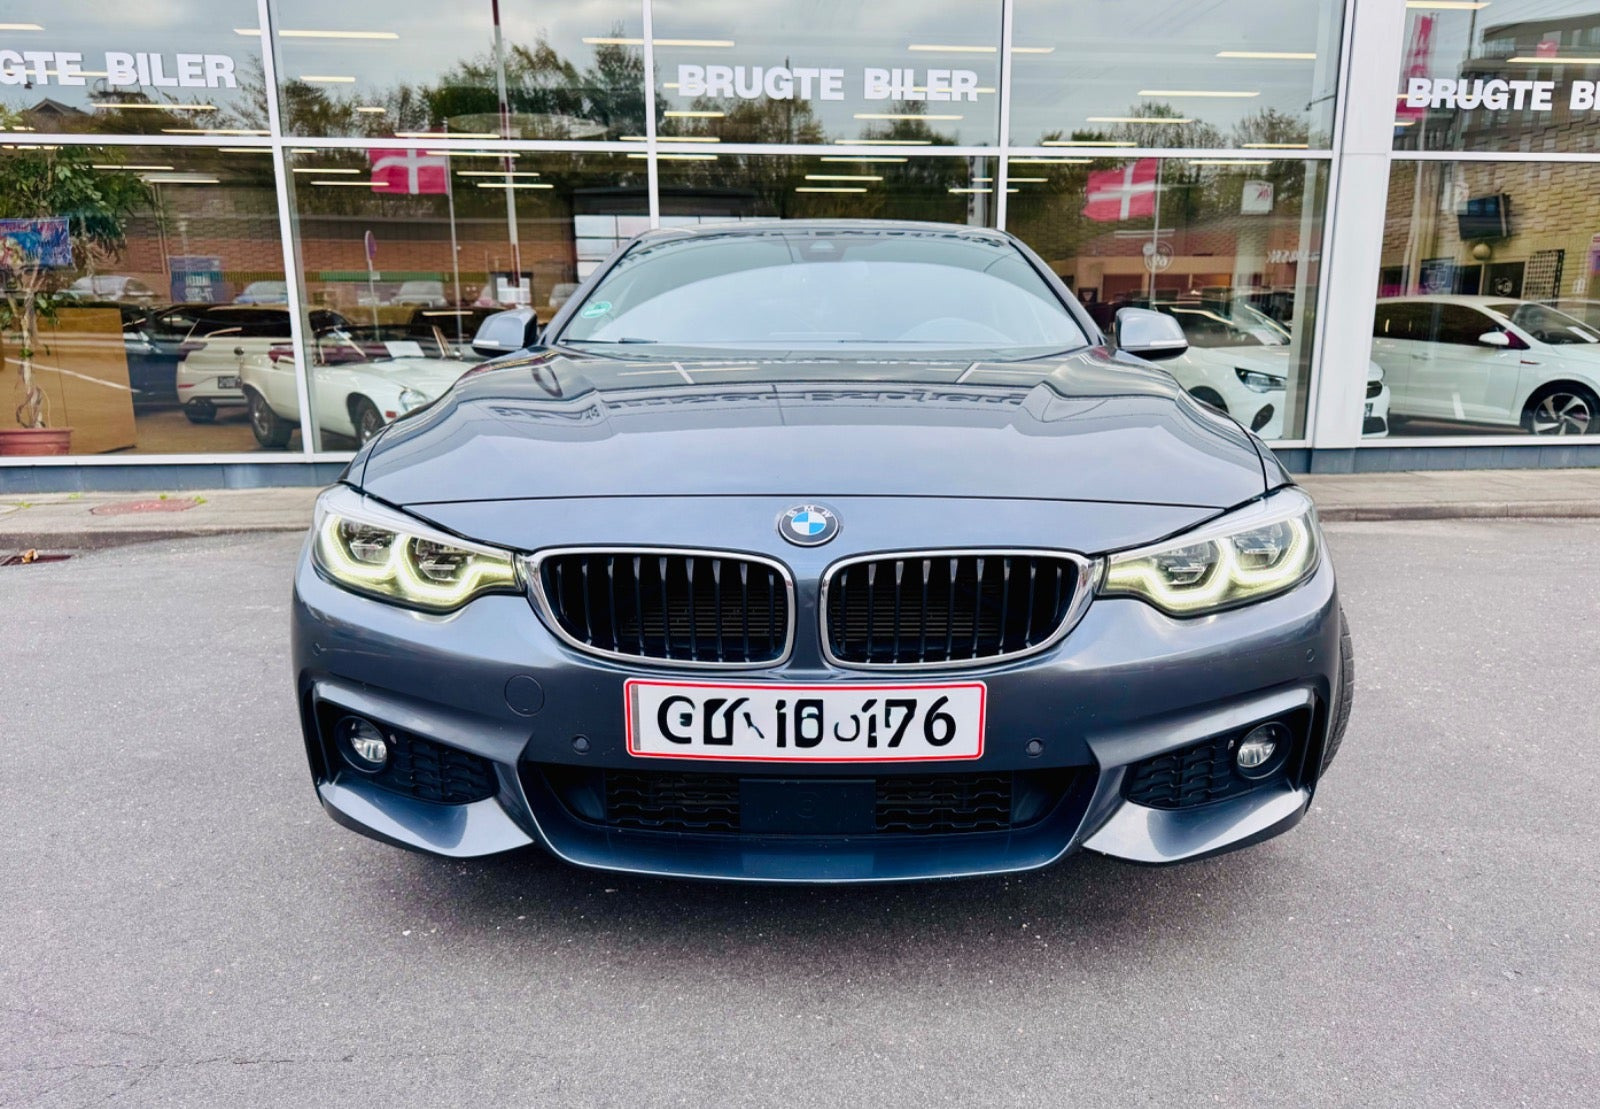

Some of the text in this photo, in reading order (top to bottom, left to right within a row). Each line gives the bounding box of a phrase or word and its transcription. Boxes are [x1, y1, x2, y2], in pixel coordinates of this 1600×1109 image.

[105, 51, 238, 89] BILER
[678, 64, 979, 102] BRUGTE BILER
[1406, 77, 1555, 111] BRUGTE
